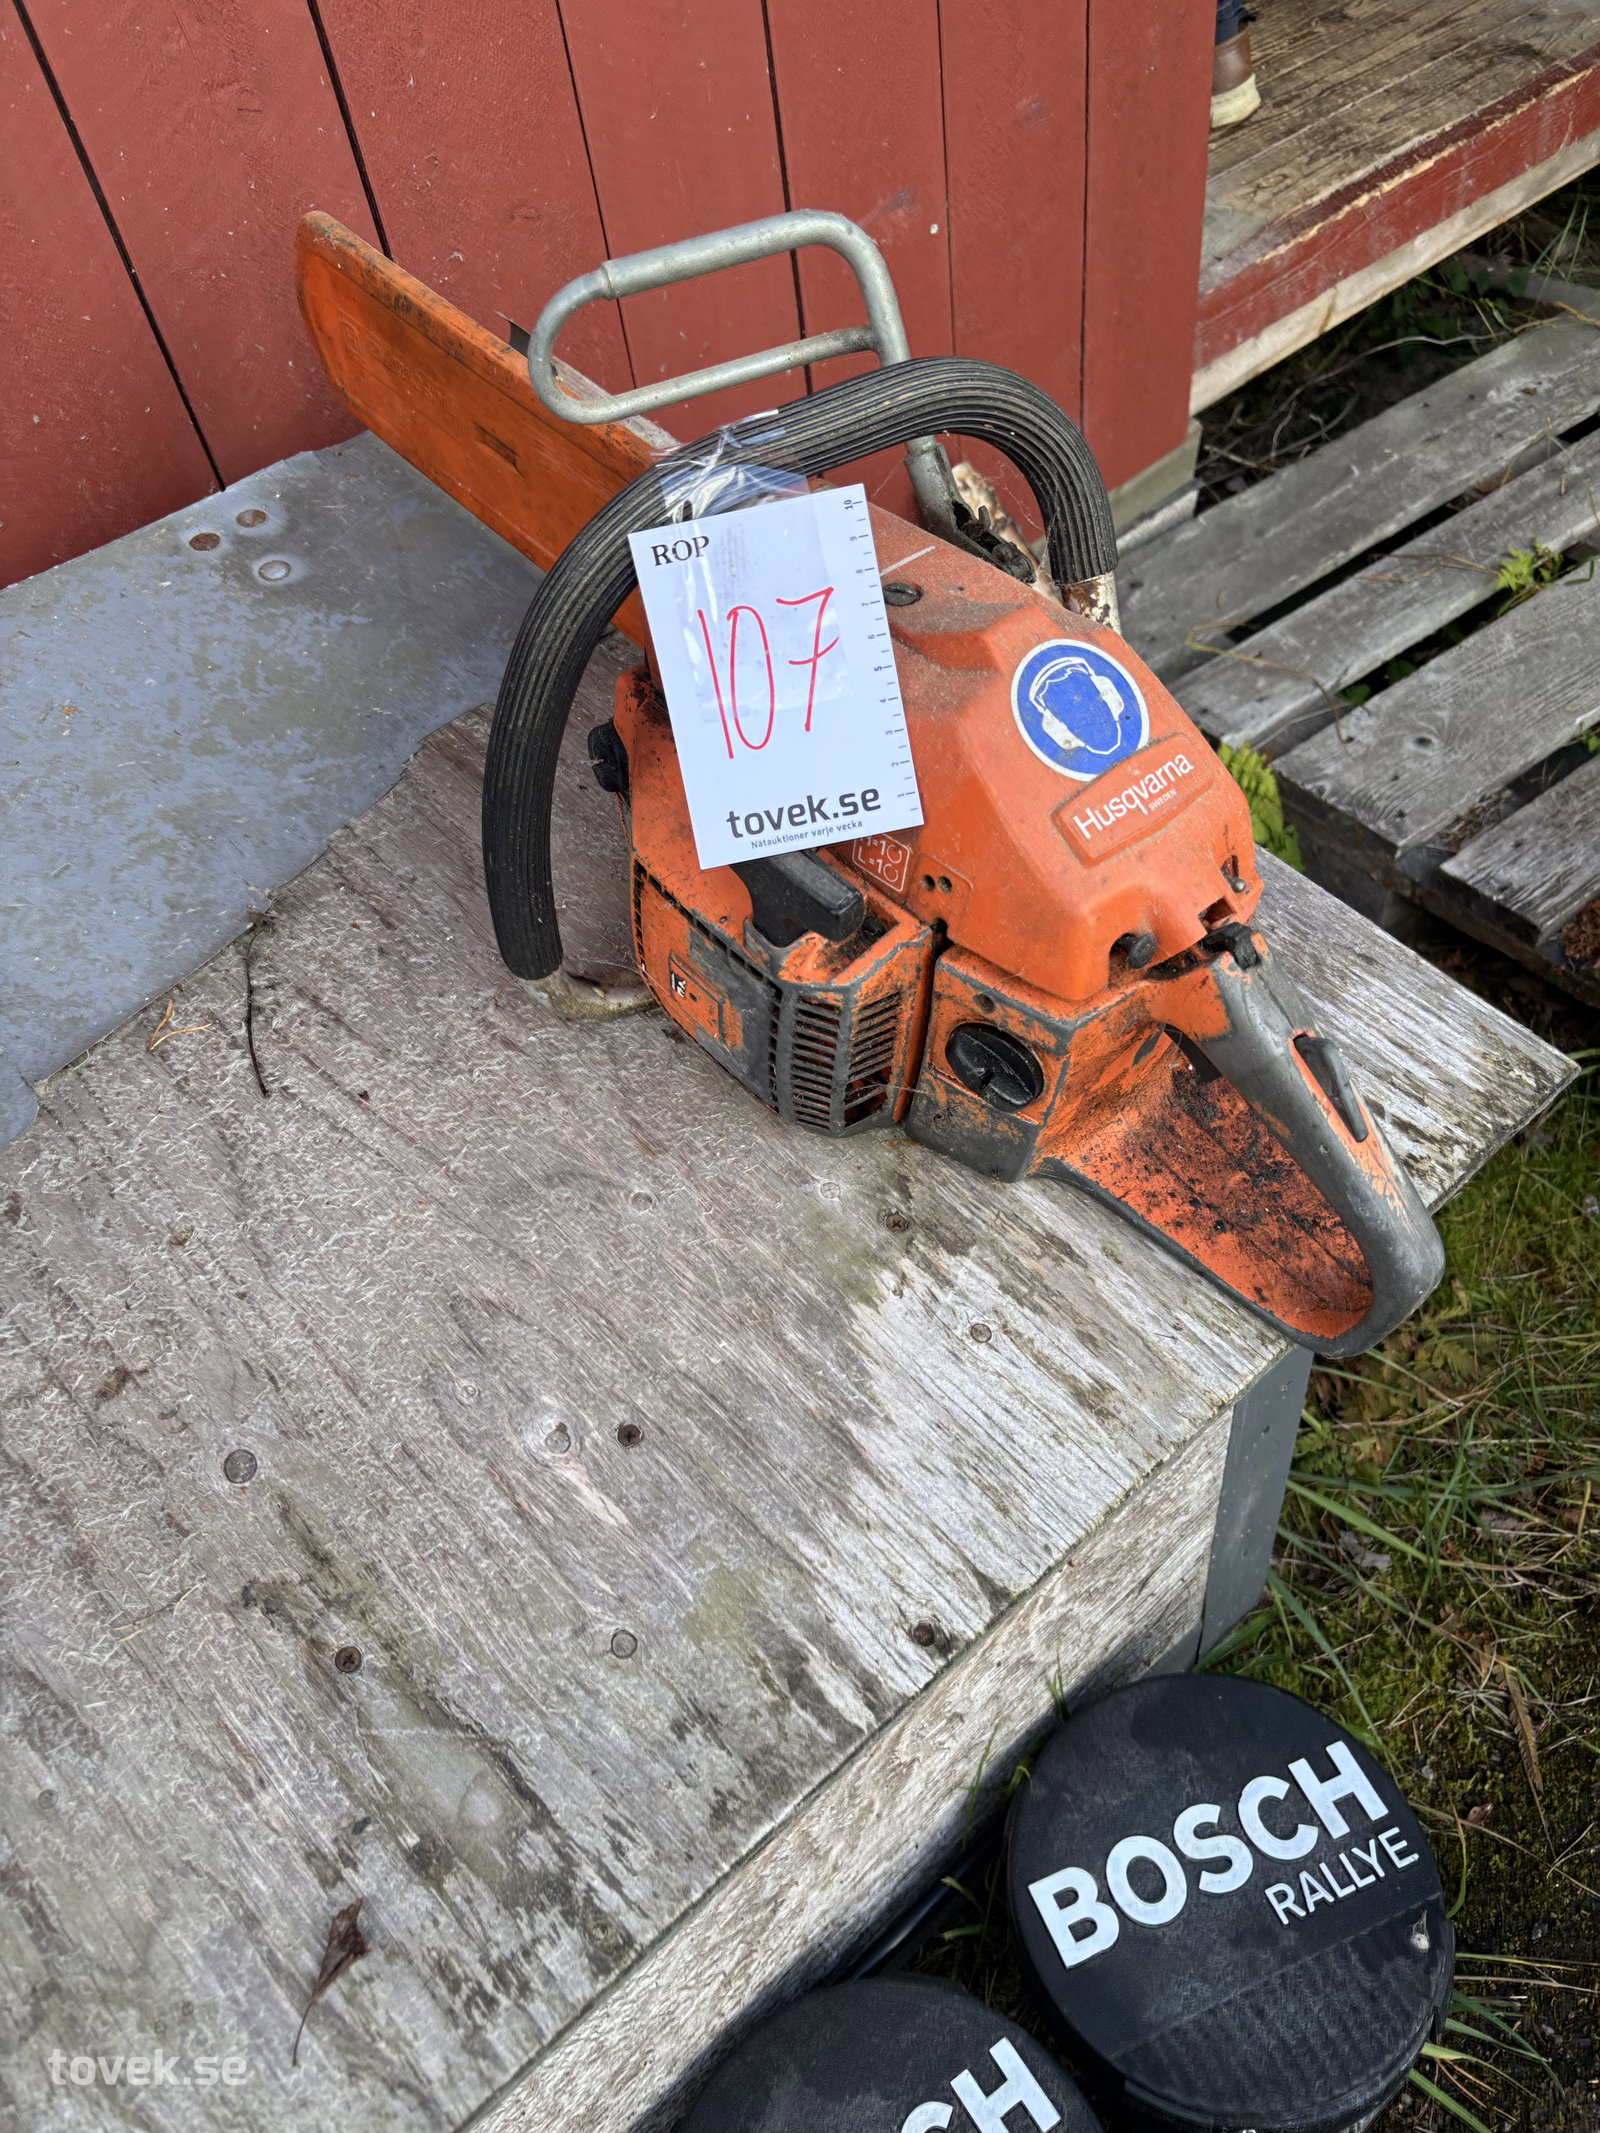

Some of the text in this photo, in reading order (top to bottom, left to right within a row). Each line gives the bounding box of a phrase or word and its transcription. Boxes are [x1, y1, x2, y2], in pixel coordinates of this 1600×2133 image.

[843, 499, 854, 510] 10
[650, 535, 710, 567] ROP
[697, 586, 839, 759] 107
[726, 788, 881, 838] tovek.se
[1073, 753, 1195, 840] Husqvarna
[751, 820, 863, 849] Nätauktioner varje vecka
[1028, 1740, 1390, 1969] BOSCH
[1264, 1826, 1420, 1926] RALLYE
